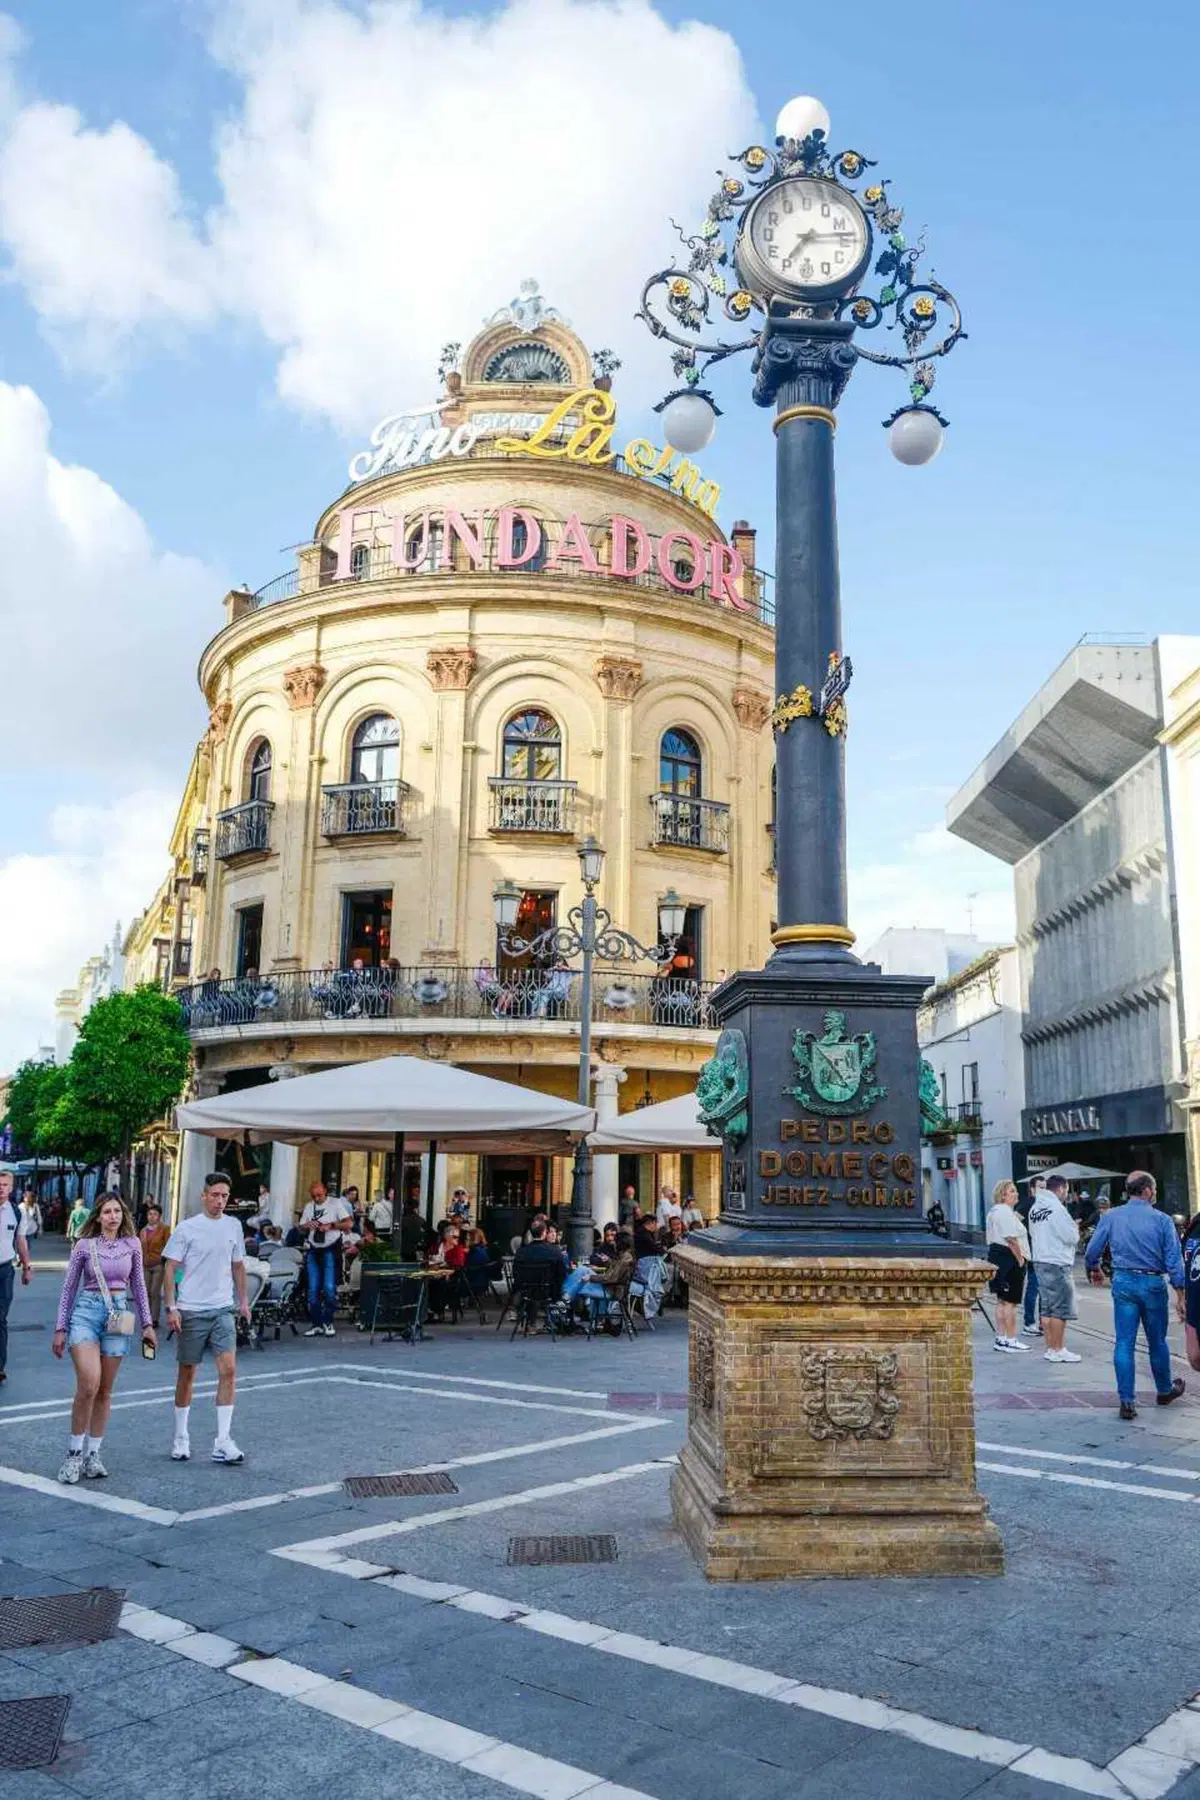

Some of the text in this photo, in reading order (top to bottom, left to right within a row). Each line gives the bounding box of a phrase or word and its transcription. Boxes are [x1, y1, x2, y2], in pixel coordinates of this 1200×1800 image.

[348, 398, 486, 482] Fino
[495, 389, 616, 465] La
[332, 504, 757, 612] FUNDADOR
[779, 1118, 896, 1144] PEDRO
[759, 1150, 915, 1184] DOMECQ
